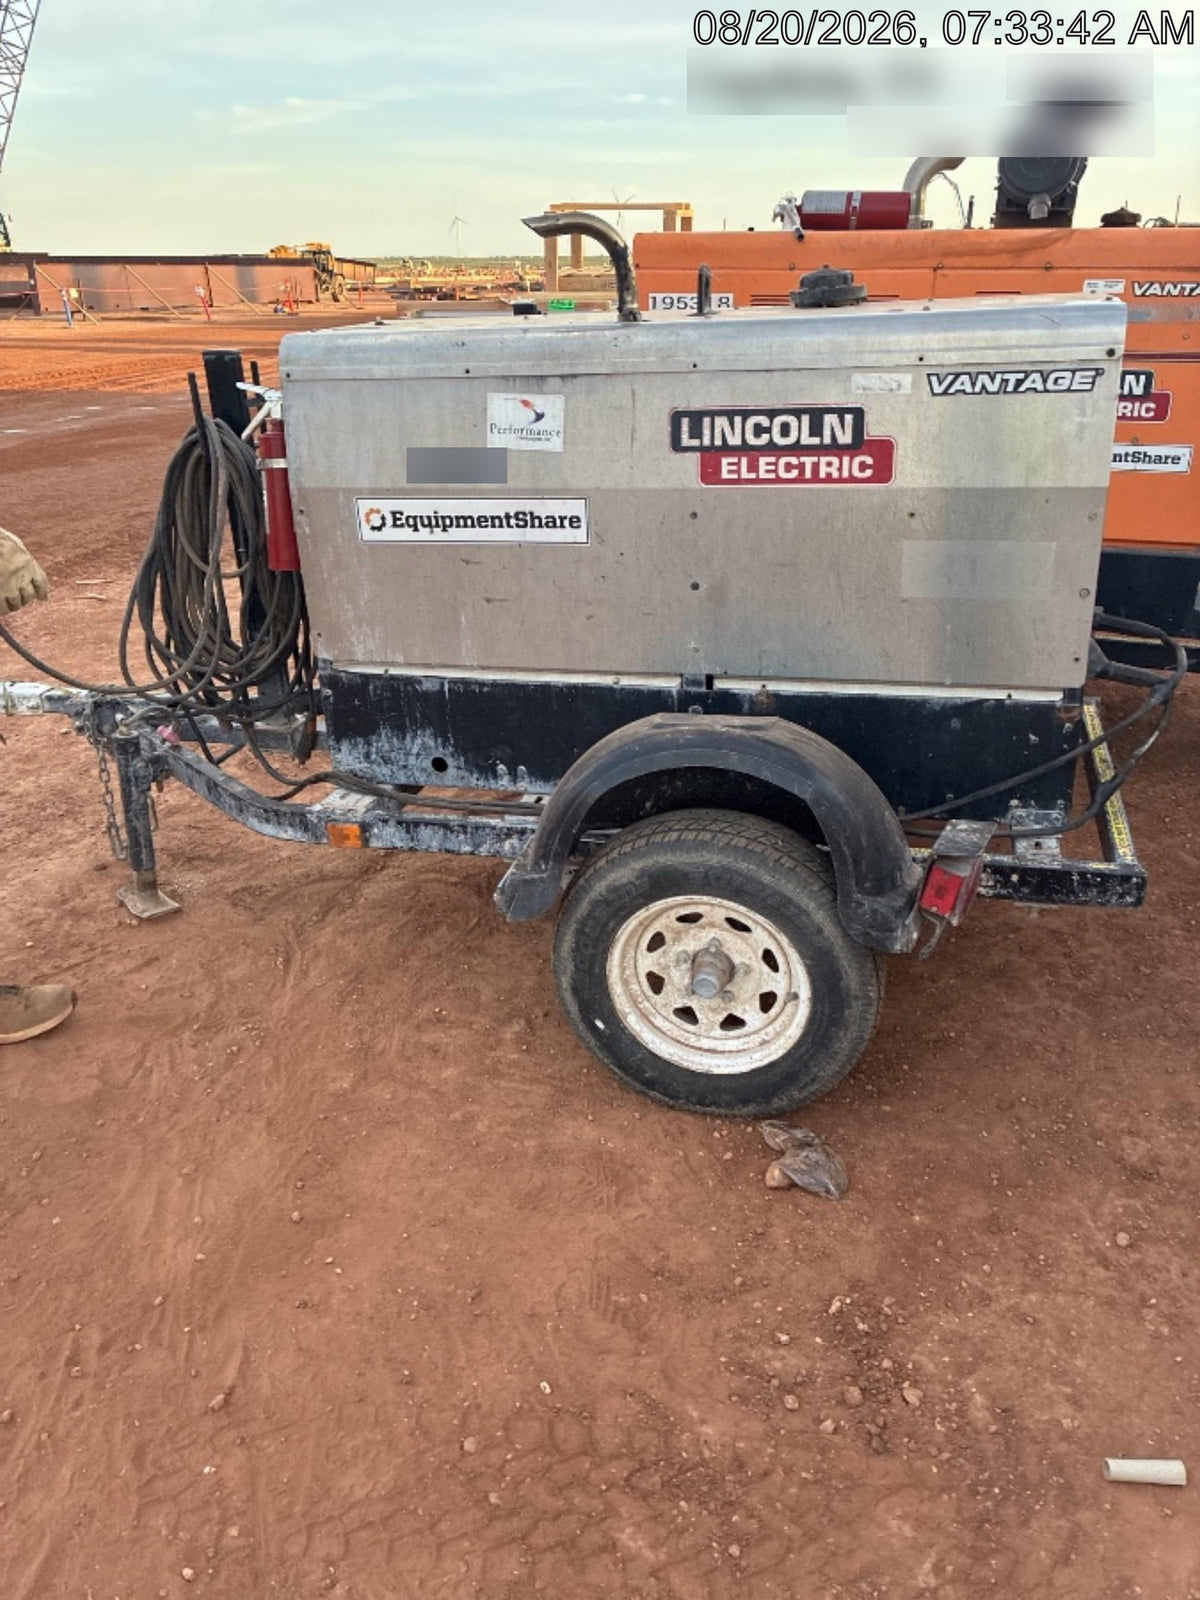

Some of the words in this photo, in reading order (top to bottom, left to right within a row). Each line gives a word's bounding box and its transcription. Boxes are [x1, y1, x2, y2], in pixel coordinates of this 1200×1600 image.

[650, 296, 730, 310] 19538
[927, 369, 1098, 396] VANTAGE
[489, 422, 562, 438] Performance
[680, 413, 854, 447] LINCOLN
[720, 455, 874, 480] ELECTRIC
[390, 510, 582, 533] EquipmentShare
